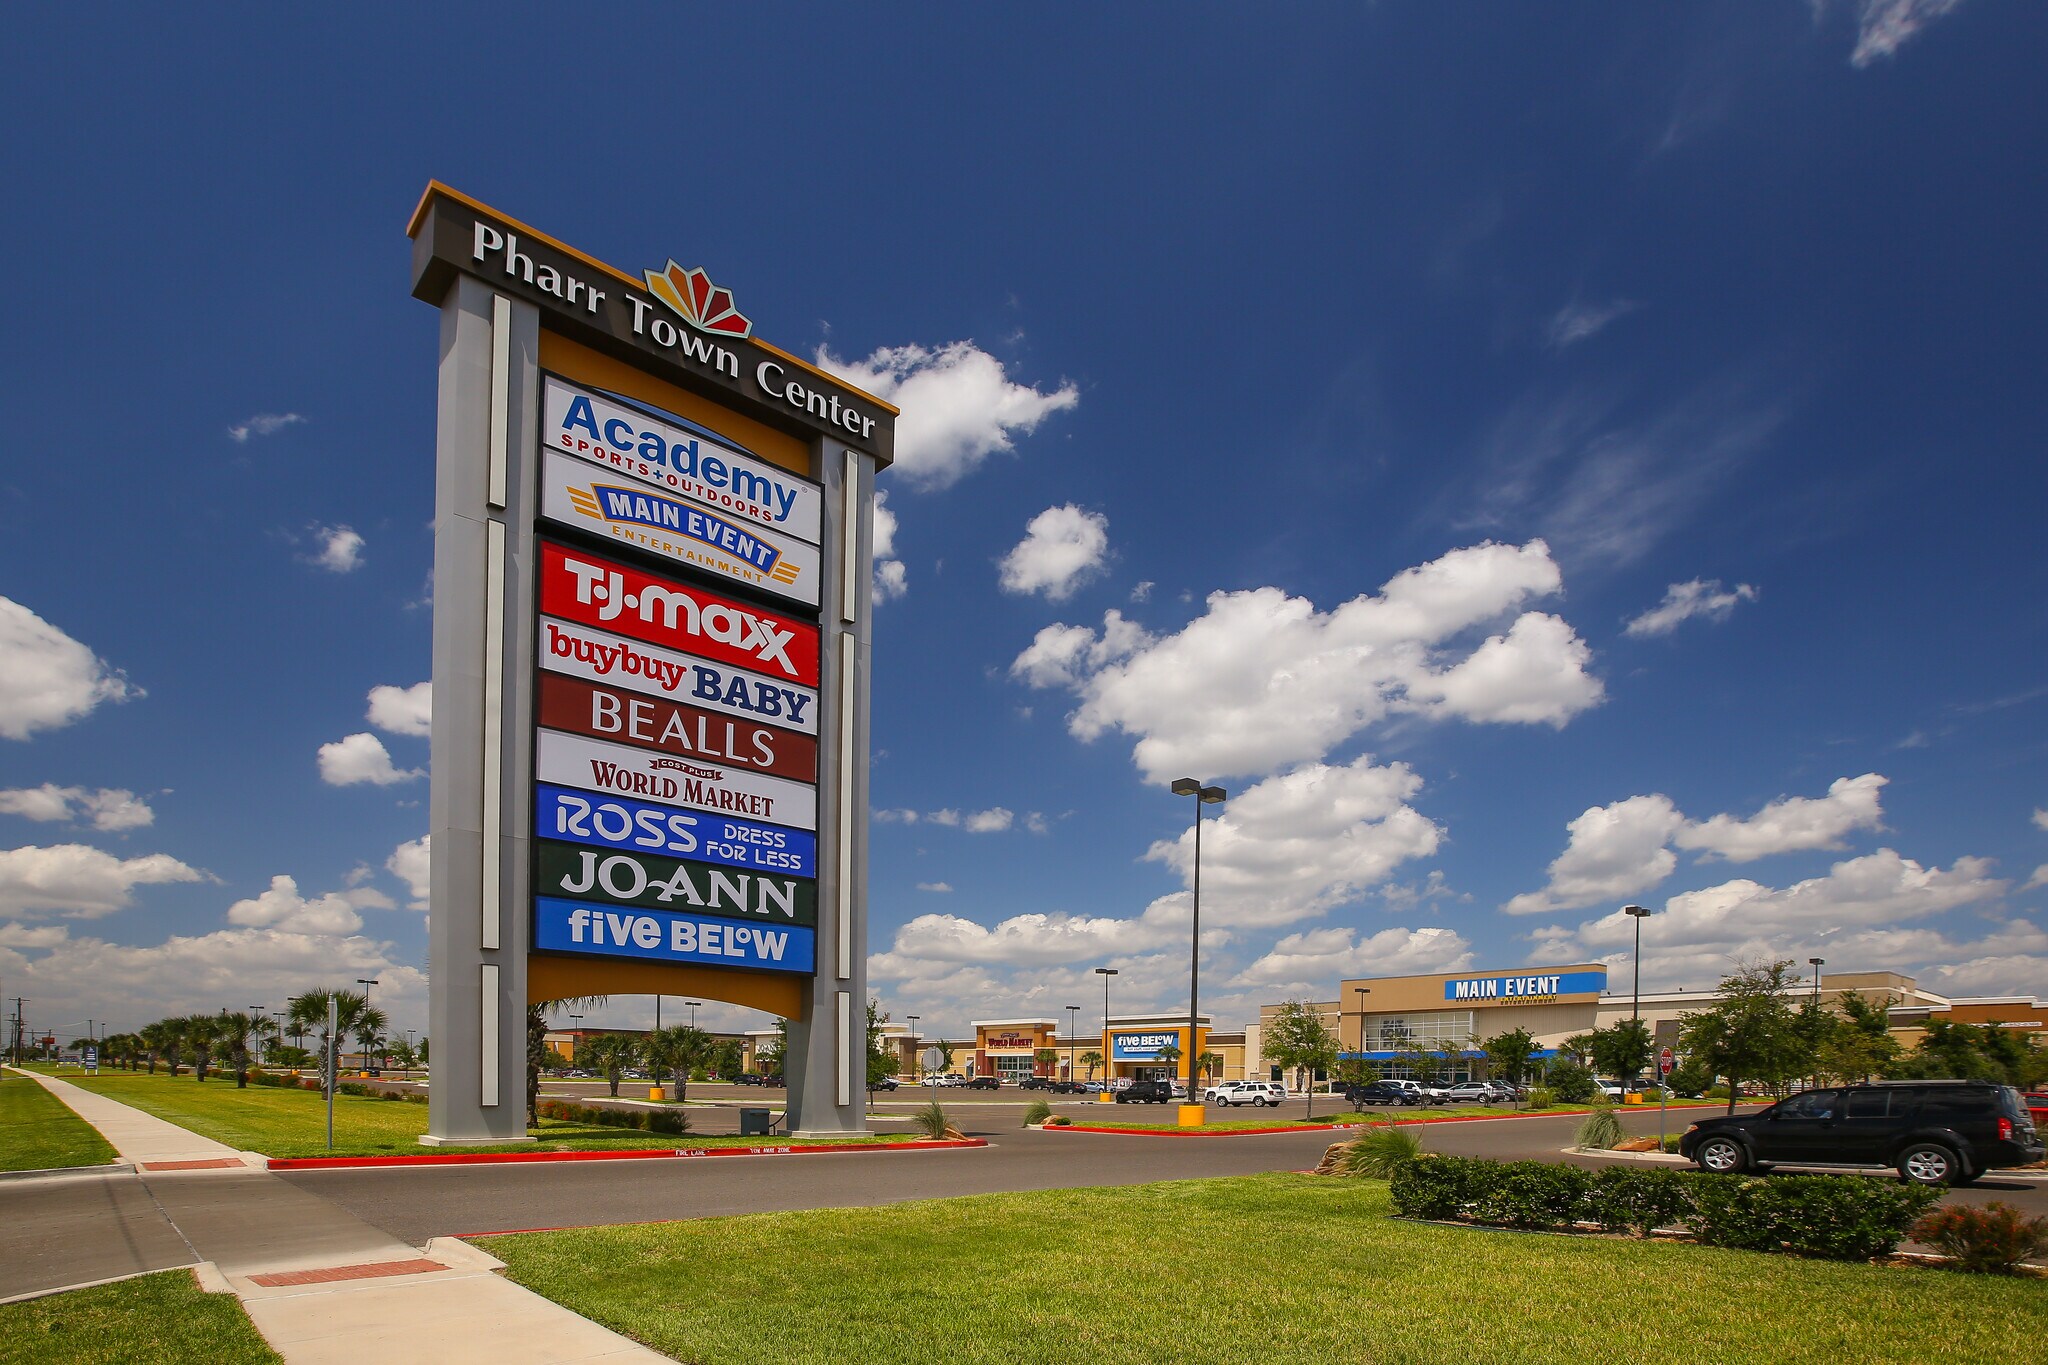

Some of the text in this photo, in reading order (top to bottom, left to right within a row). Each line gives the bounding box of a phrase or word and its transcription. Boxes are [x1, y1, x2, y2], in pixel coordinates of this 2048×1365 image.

[473, 221, 876, 440] Pharr Town Center
[562, 395, 797, 523] Academy
[607, 492, 772, 566] MAIN EVENT
[612, 525, 763, 583] ENTERTAINMENT
[591, 690, 775, 767] BEALLS
[590, 759, 774, 818] WORLD MARKET
[661, 760, 713, 777] COST PLUS
[557, 795, 786, 853] ROSS DRESS
[706, 841, 802, 870] FOR LESS
[1456, 976, 1560, 998] MAIN EVENT
[1660, 1056, 1672, 1067] STOP
[675, 1149, 689, 1157] FIRE
